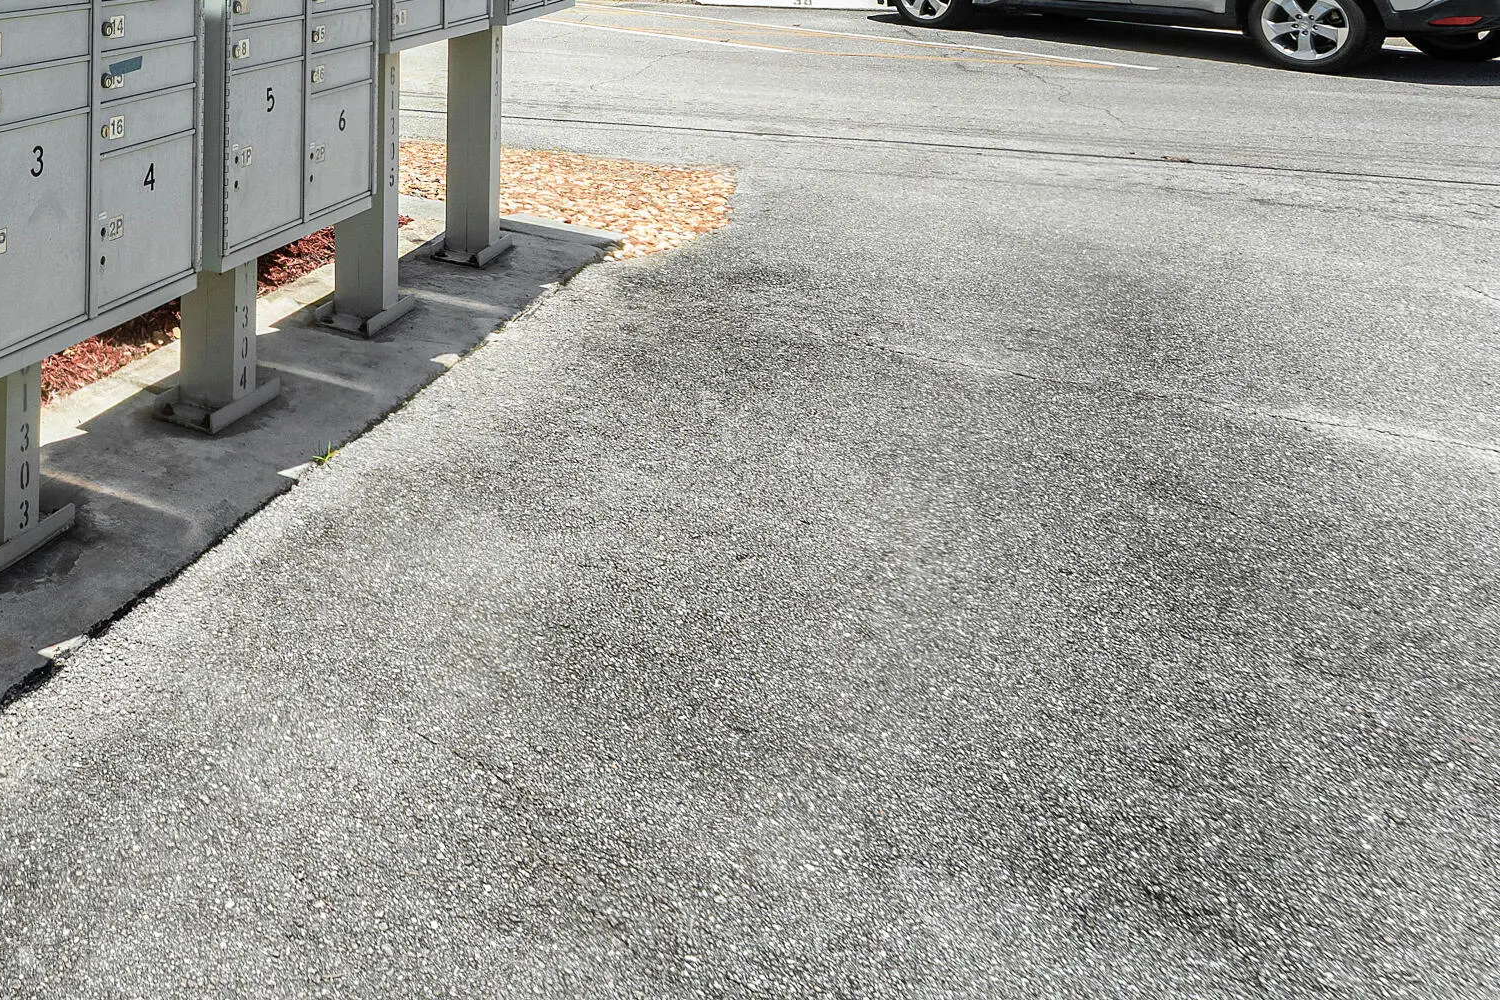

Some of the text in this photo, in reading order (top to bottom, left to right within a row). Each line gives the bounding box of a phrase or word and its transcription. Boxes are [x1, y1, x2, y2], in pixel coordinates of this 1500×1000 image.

[111, 19, 124, 35] 14
[242, 42, 248, 56] 8
[266, 87, 275, 113] 5
[111, 118, 124, 136] 16
[338, 109, 347, 132] 6
[30, 145, 45, 178] 3
[241, 150, 251, 165] 1P
[143, 162, 156, 192] 4
[108, 217, 123, 238] 2P
